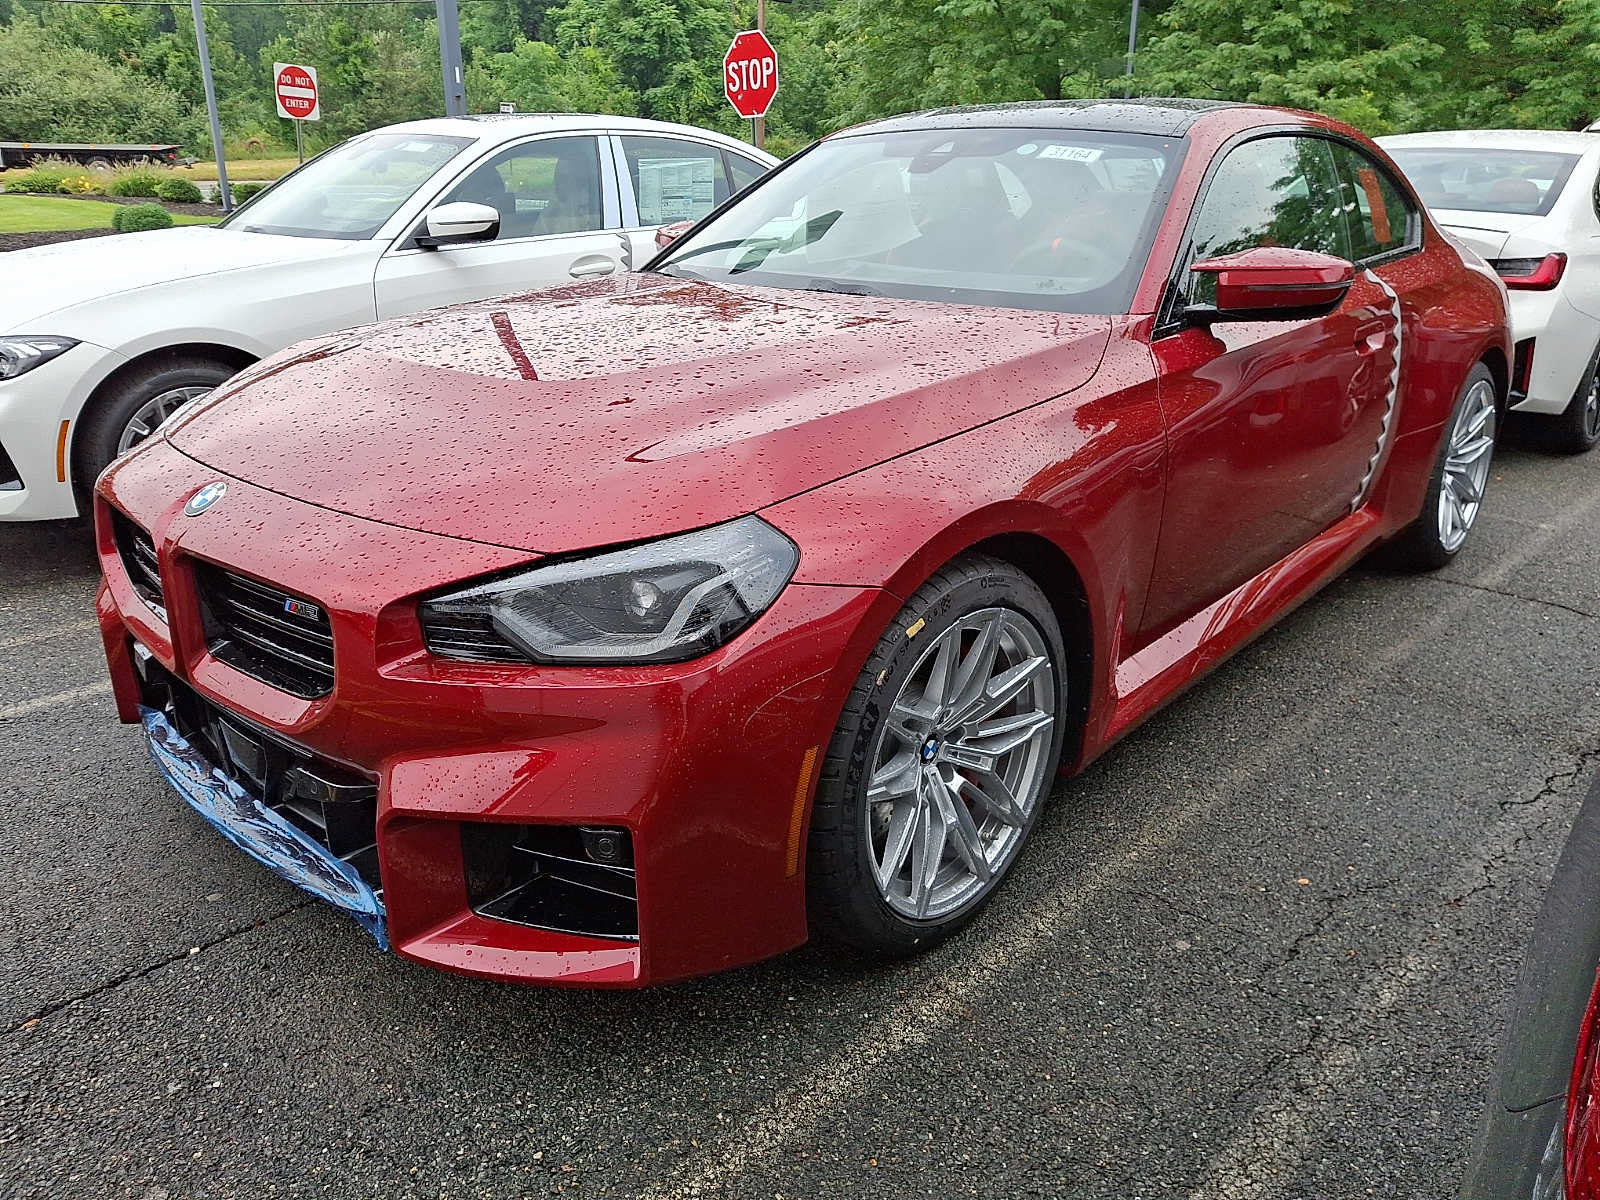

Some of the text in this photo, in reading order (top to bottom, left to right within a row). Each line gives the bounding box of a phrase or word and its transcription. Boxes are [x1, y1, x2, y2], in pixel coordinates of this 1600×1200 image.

[281, 74, 310, 87] DO NOT
[728, 56, 774, 92] STOP
[285, 98, 310, 109] ENTER
